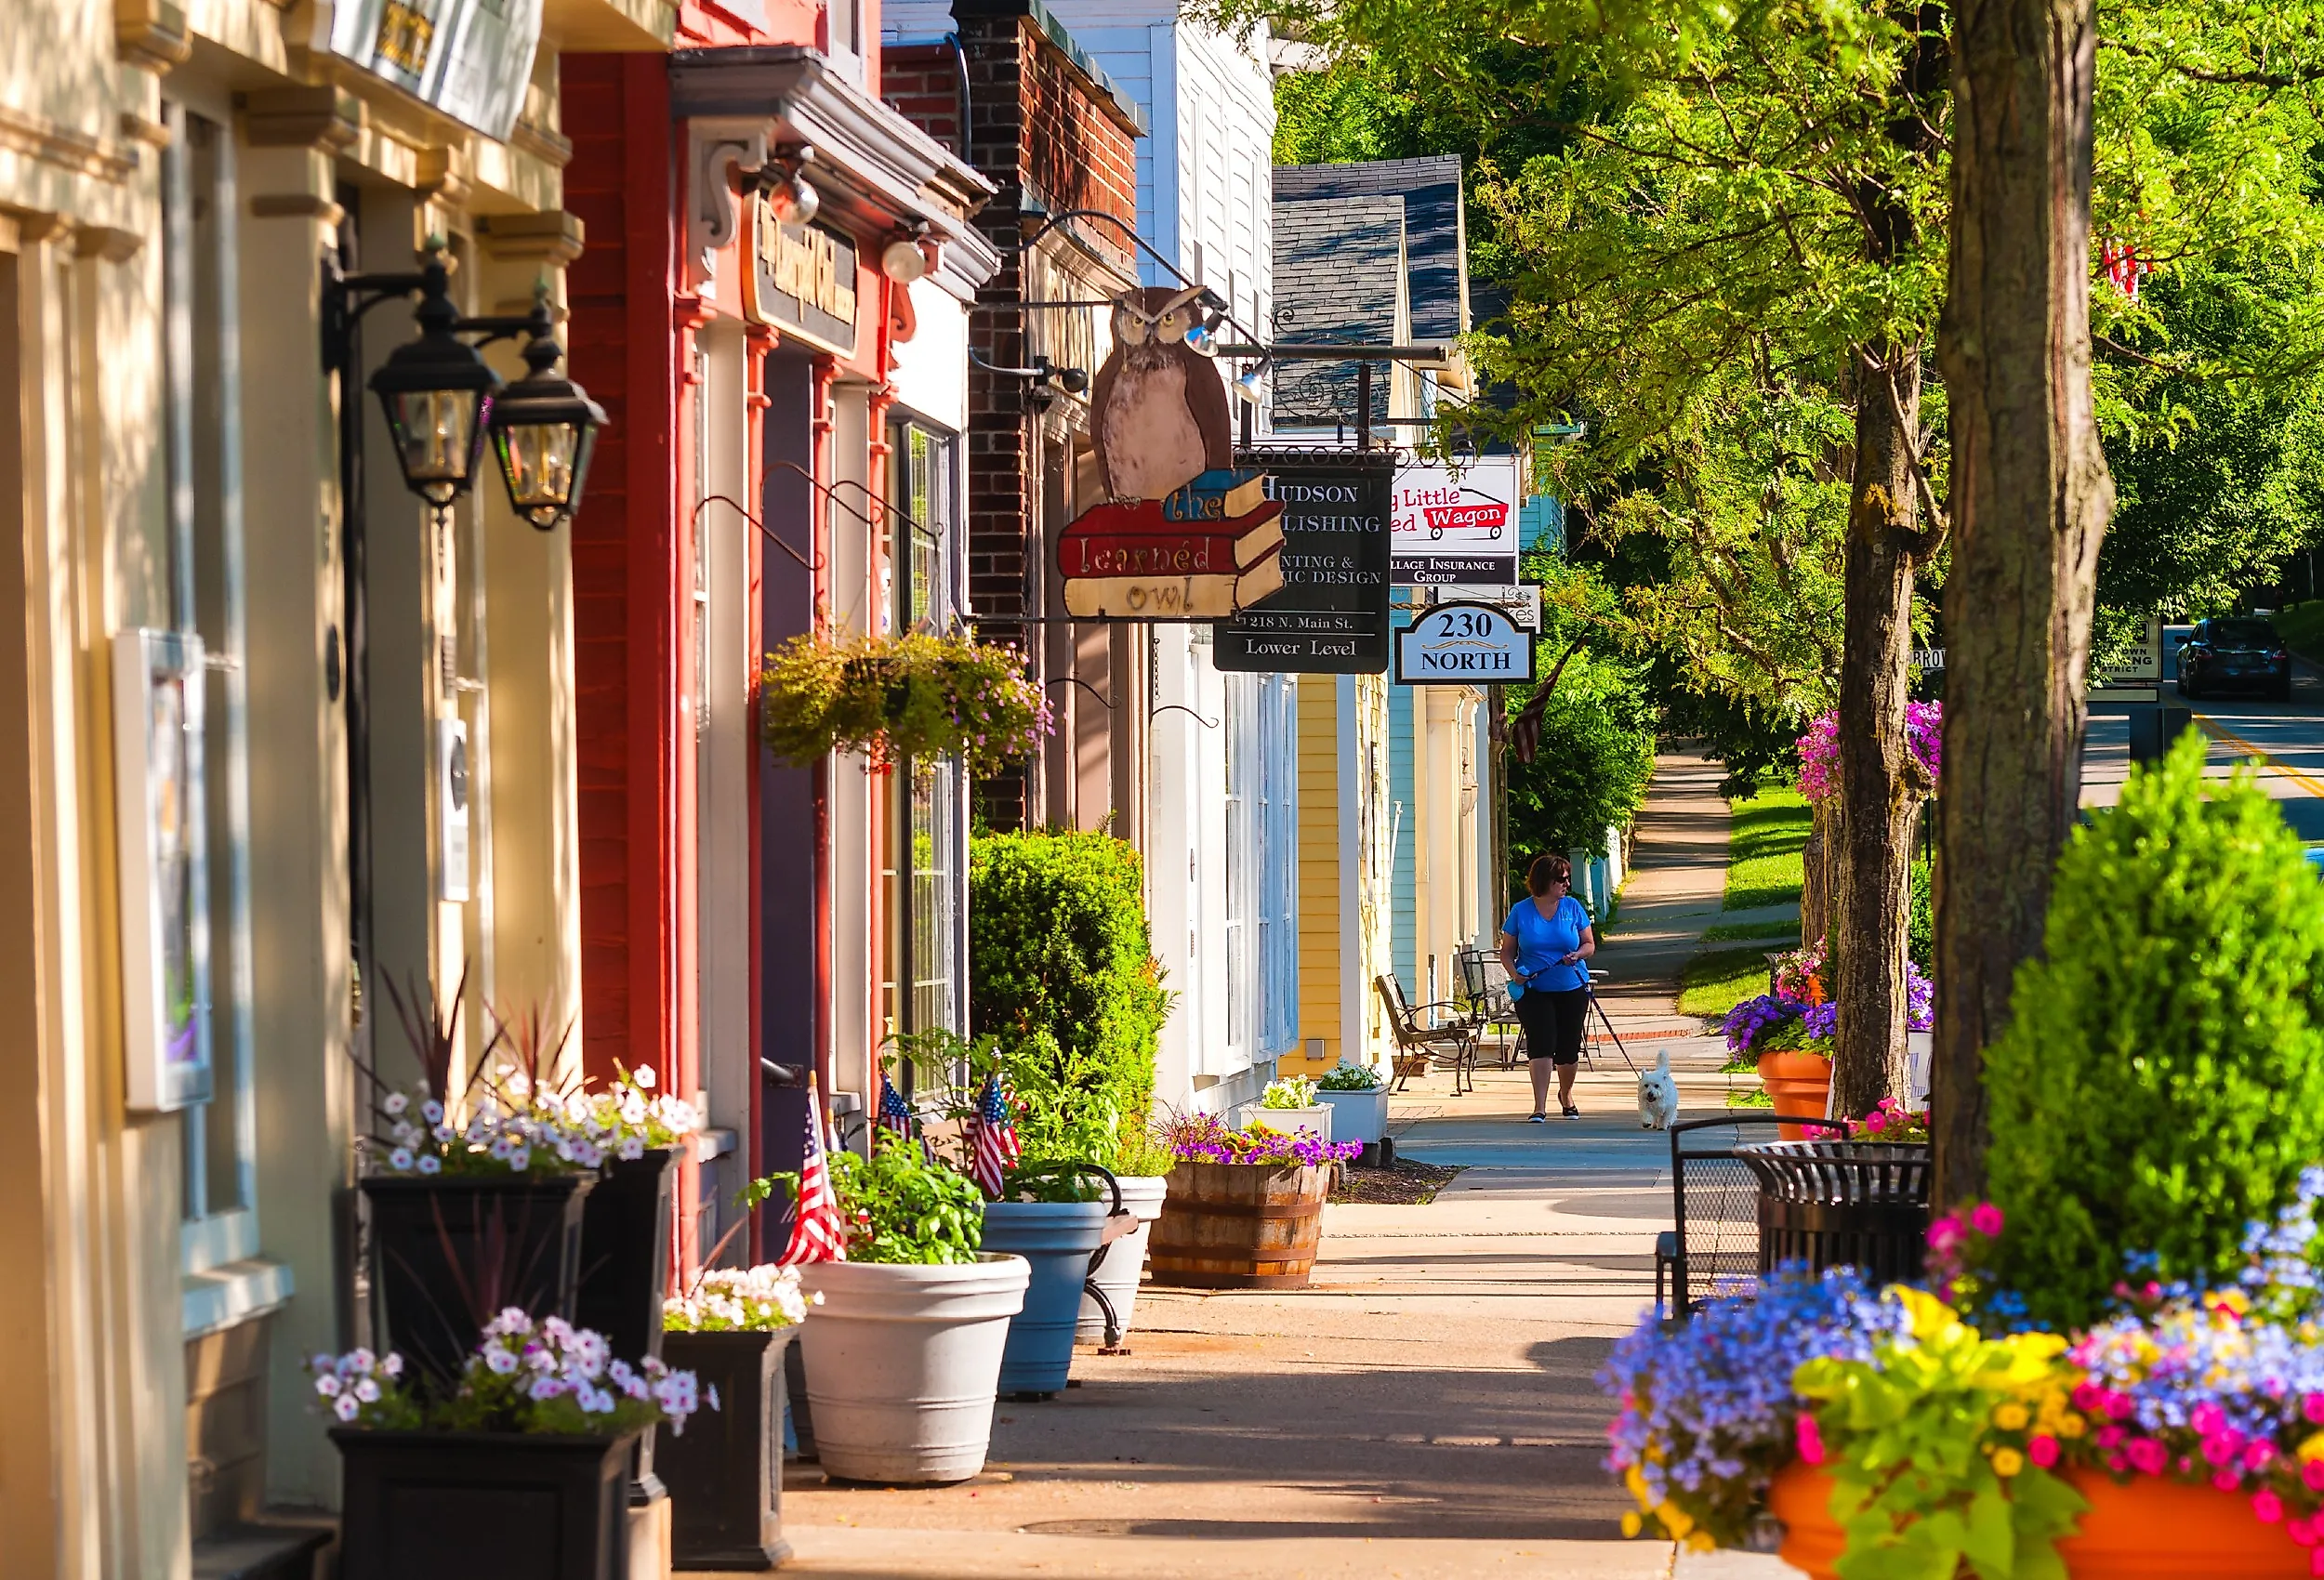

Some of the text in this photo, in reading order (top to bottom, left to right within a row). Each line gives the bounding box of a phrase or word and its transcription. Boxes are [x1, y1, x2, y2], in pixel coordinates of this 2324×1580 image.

[1261, 475, 1359, 503] HUDSON
[1403, 488, 1460, 507] Little
[1172, 483, 1222, 521] the
[1431, 508, 1501, 529] Wagon
[1341, 555, 1354, 569] &
[1430, 558, 1496, 571] INSURANCE
[1313, 571, 1382, 585] DESIGN
[1414, 570, 1457, 583] GROUP
[1127, 576, 1194, 615] owl
[1278, 616, 1293, 628] N.
[1298, 617, 1331, 629] Main
[1335, 618, 1353, 630] St.
[1438, 613, 1493, 638] 230
[1246, 639, 1357, 656] Lower Level
[1420, 652, 1512, 670] NORTH
